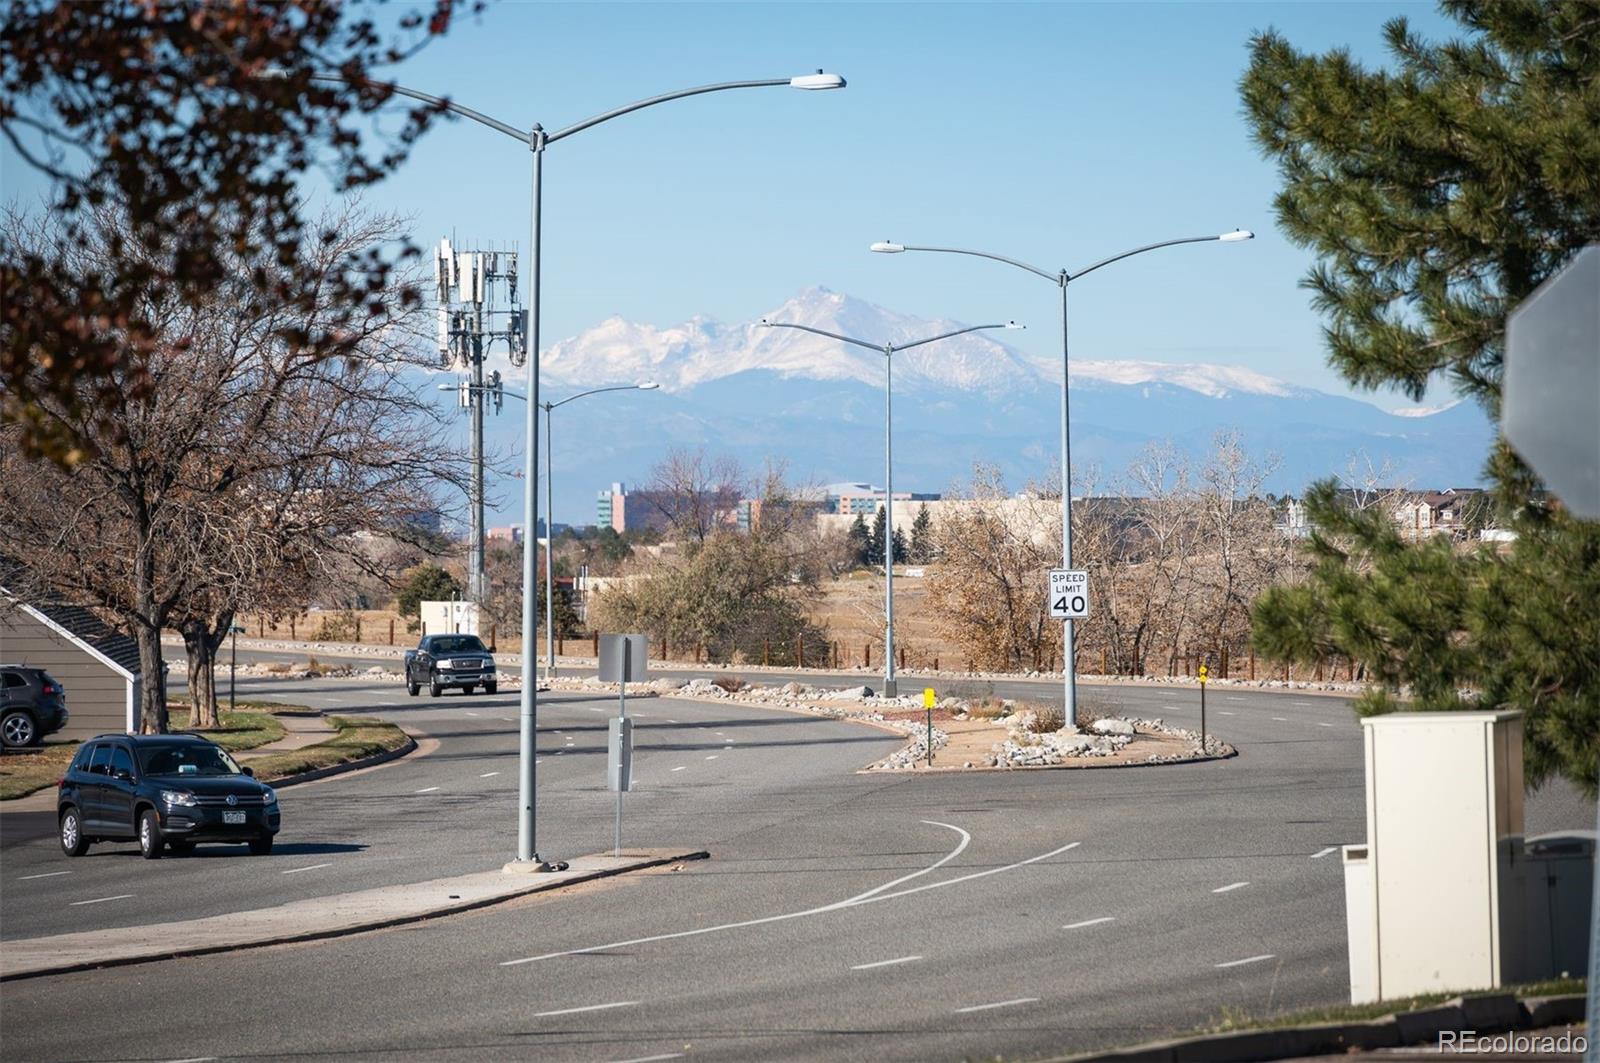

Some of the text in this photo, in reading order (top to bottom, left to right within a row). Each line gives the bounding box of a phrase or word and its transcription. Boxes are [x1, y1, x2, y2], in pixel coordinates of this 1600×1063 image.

[1052, 574, 1085, 582] SPEED
[1056, 585, 1081, 593] LIMIT
[1053, 596, 1085, 613] 40
